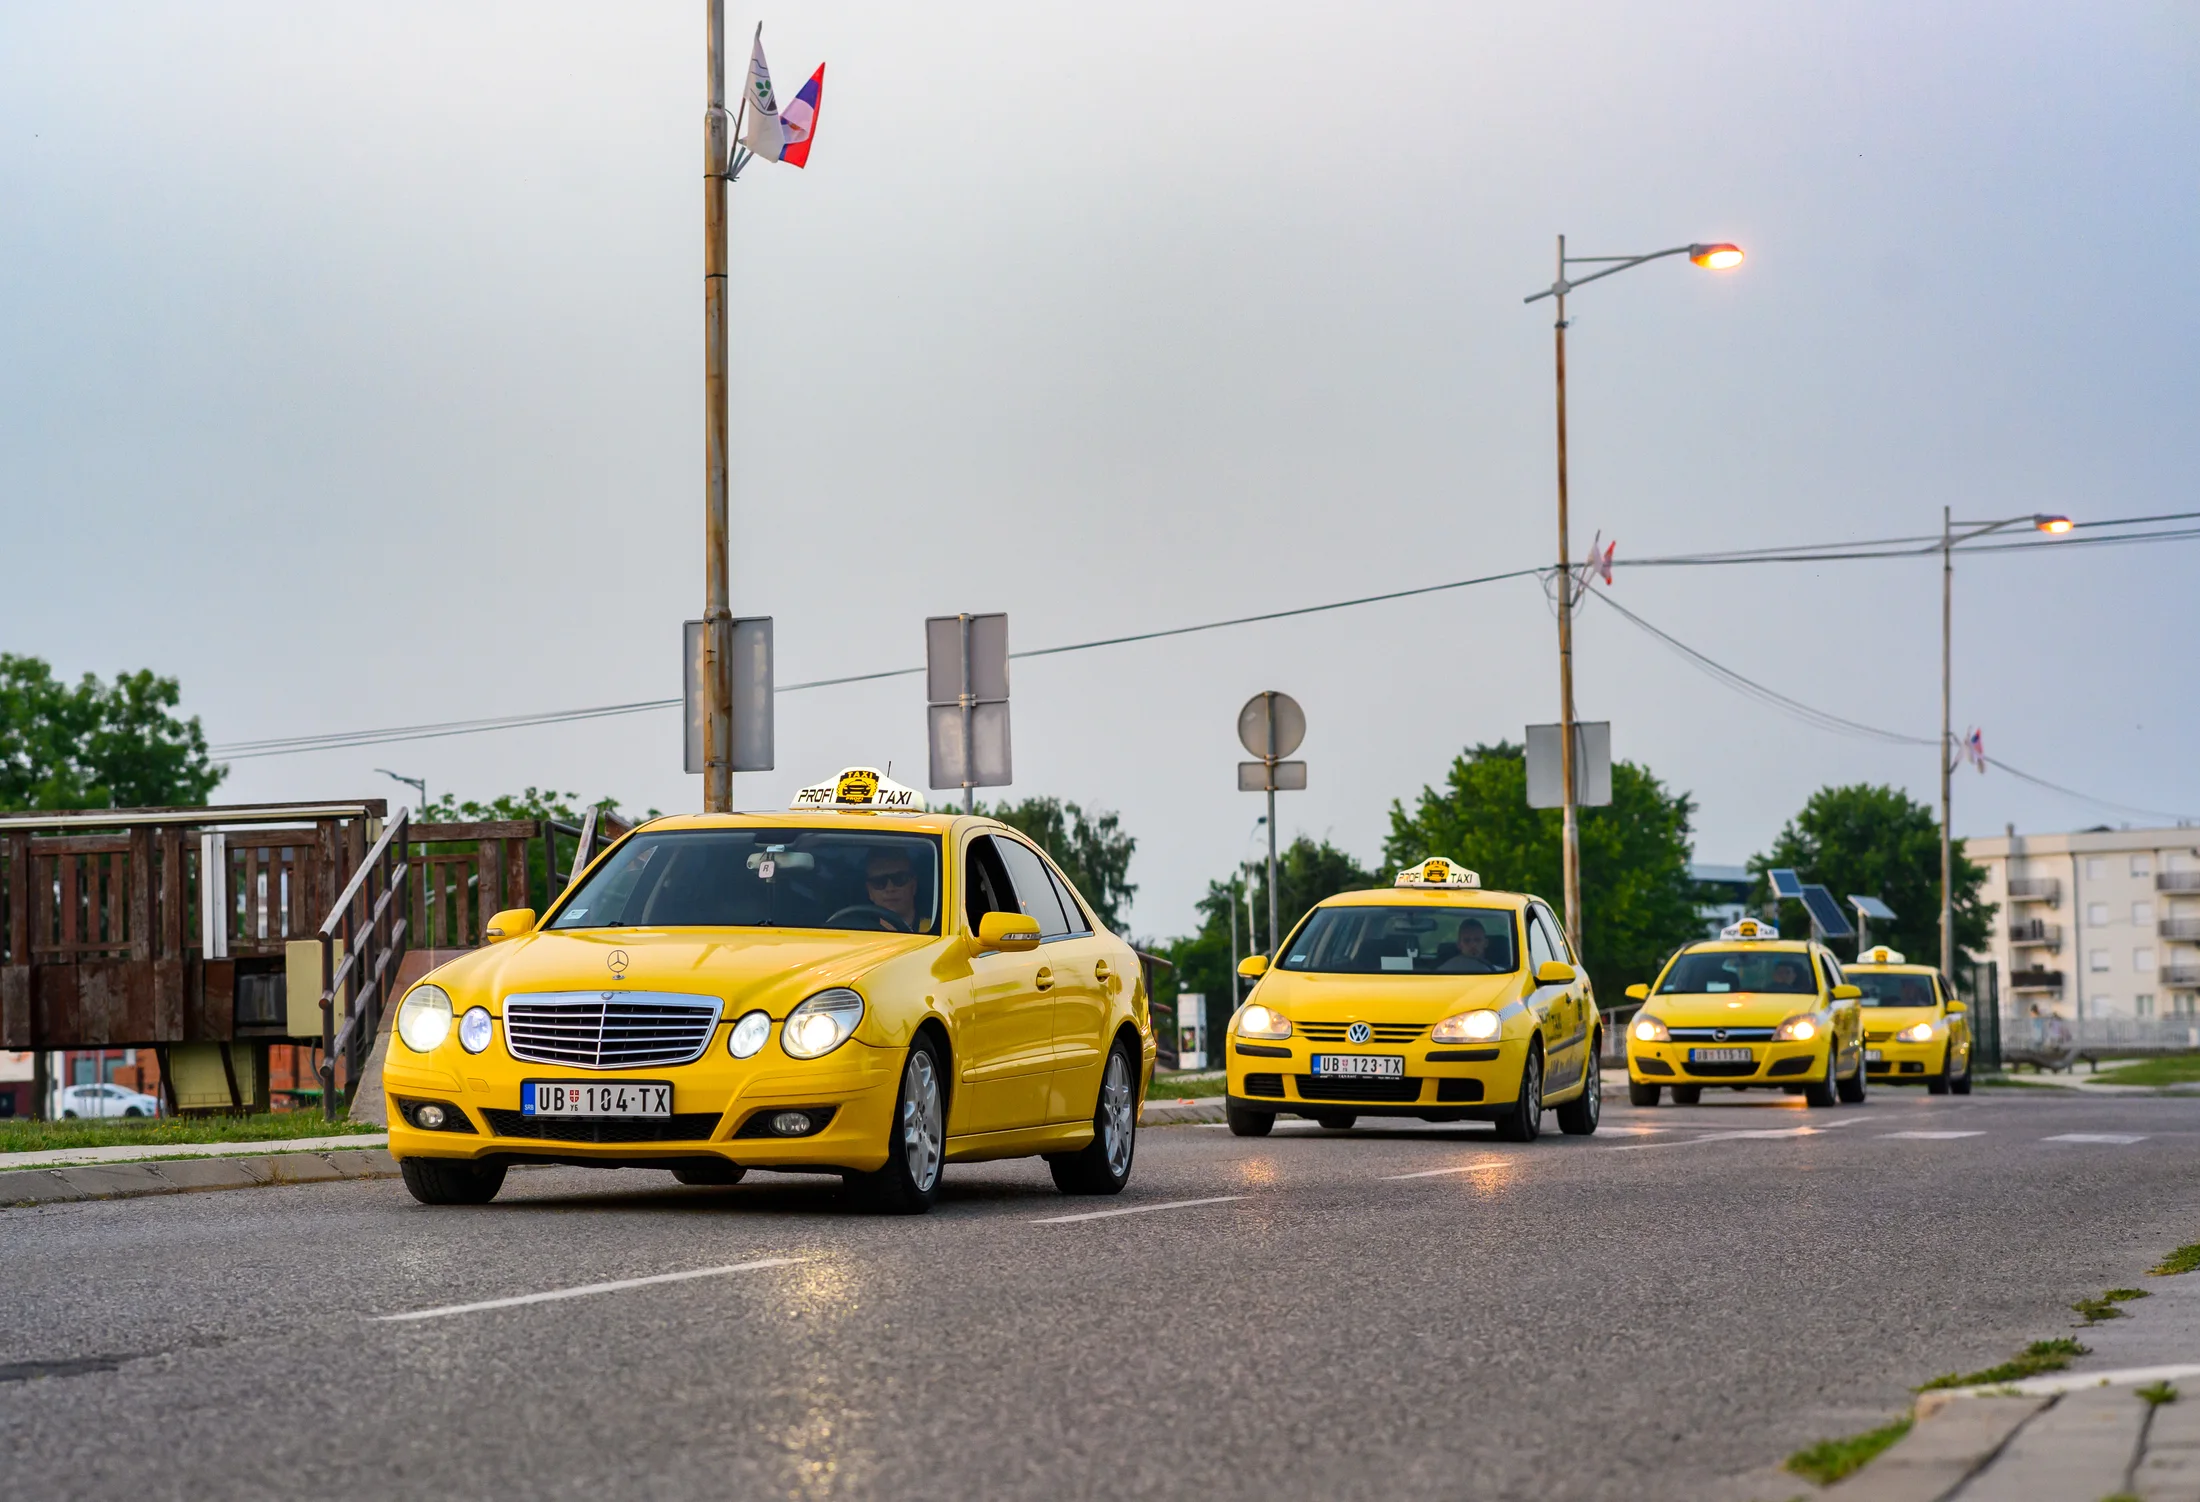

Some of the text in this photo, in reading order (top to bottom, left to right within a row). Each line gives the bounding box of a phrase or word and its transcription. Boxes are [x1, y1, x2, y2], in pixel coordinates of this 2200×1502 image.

[847, 770, 873, 779] TAXI
[798, 788, 912, 804] PROFI TAXI
[1398, 872, 1420, 882] PROFI
[1451, 873, 1472, 883] TAXI
[1323, 1057, 1340, 1071] UB
[539, 1087, 565, 1111] UB
